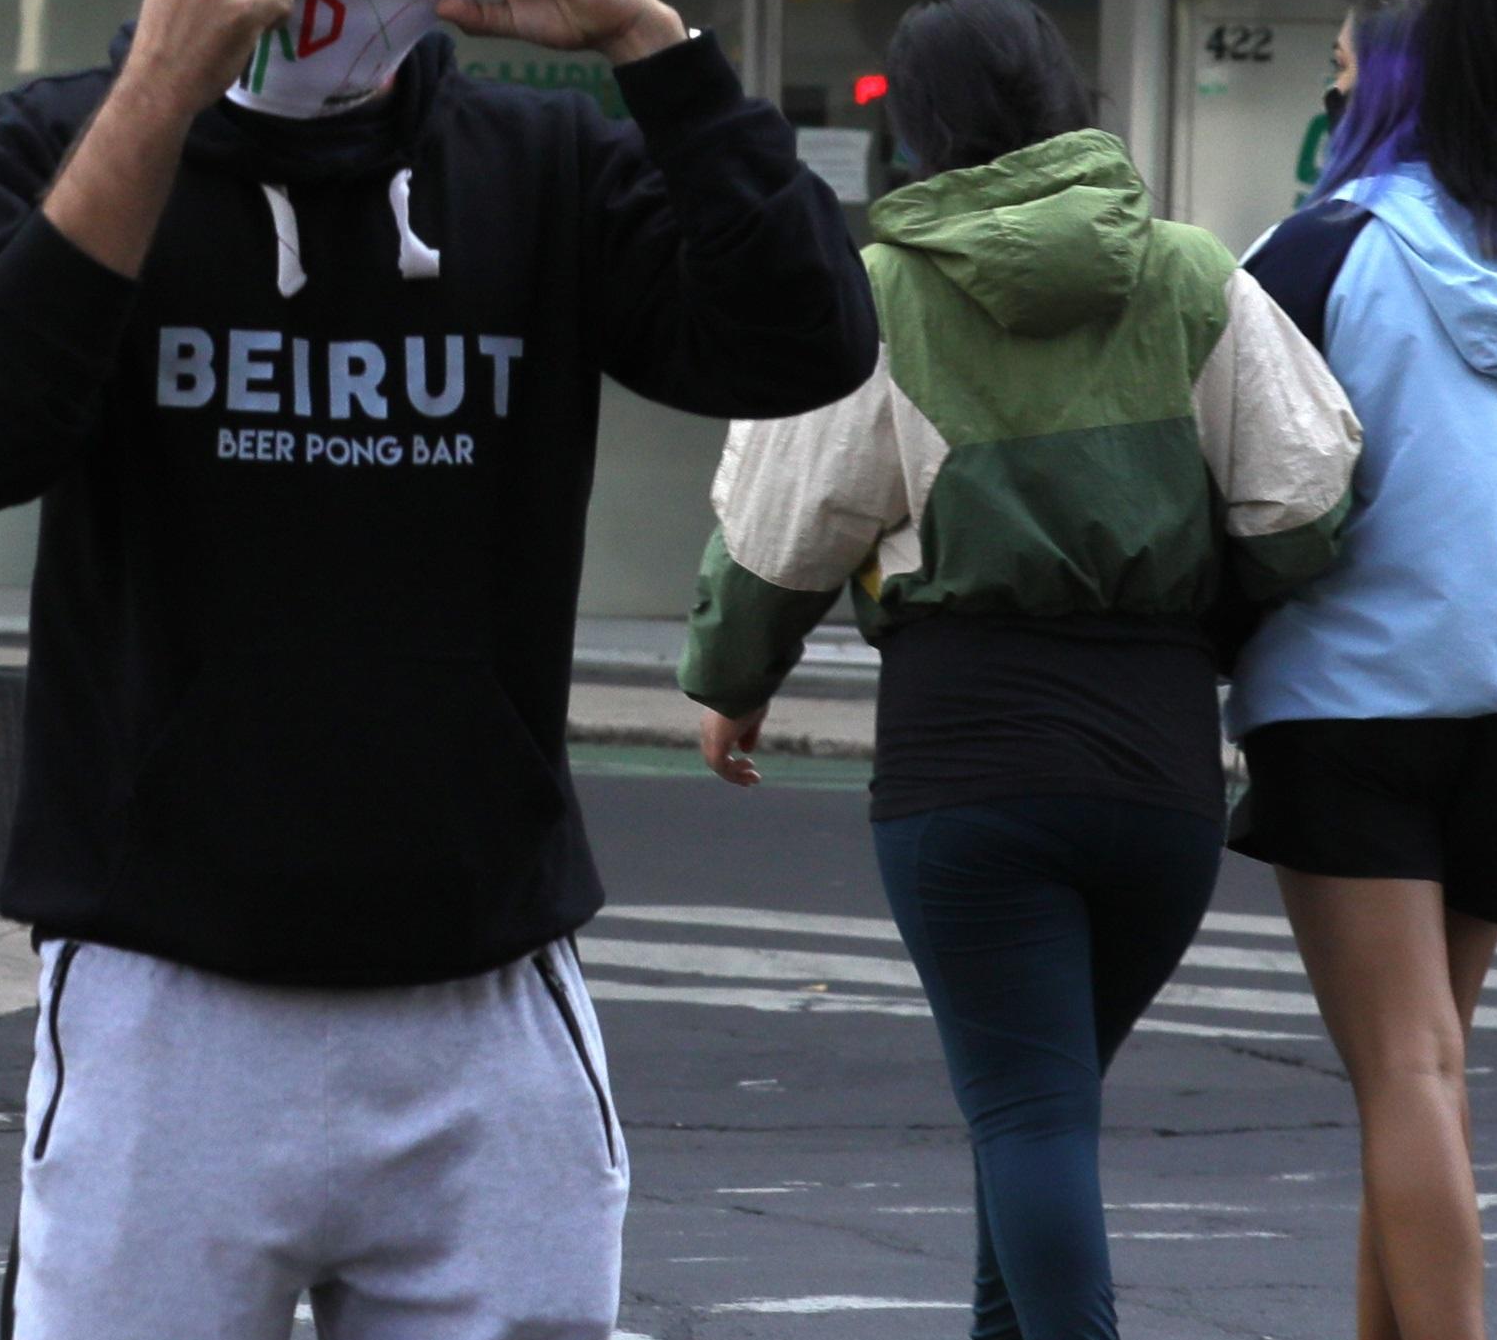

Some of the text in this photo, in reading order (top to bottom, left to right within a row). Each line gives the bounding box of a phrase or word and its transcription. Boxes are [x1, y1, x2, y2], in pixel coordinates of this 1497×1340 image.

[1206, 26, 1274, 62] 422
[156, 326, 524, 420] BEIRUT
[217, 428, 474, 467] BEER PONG BAR
